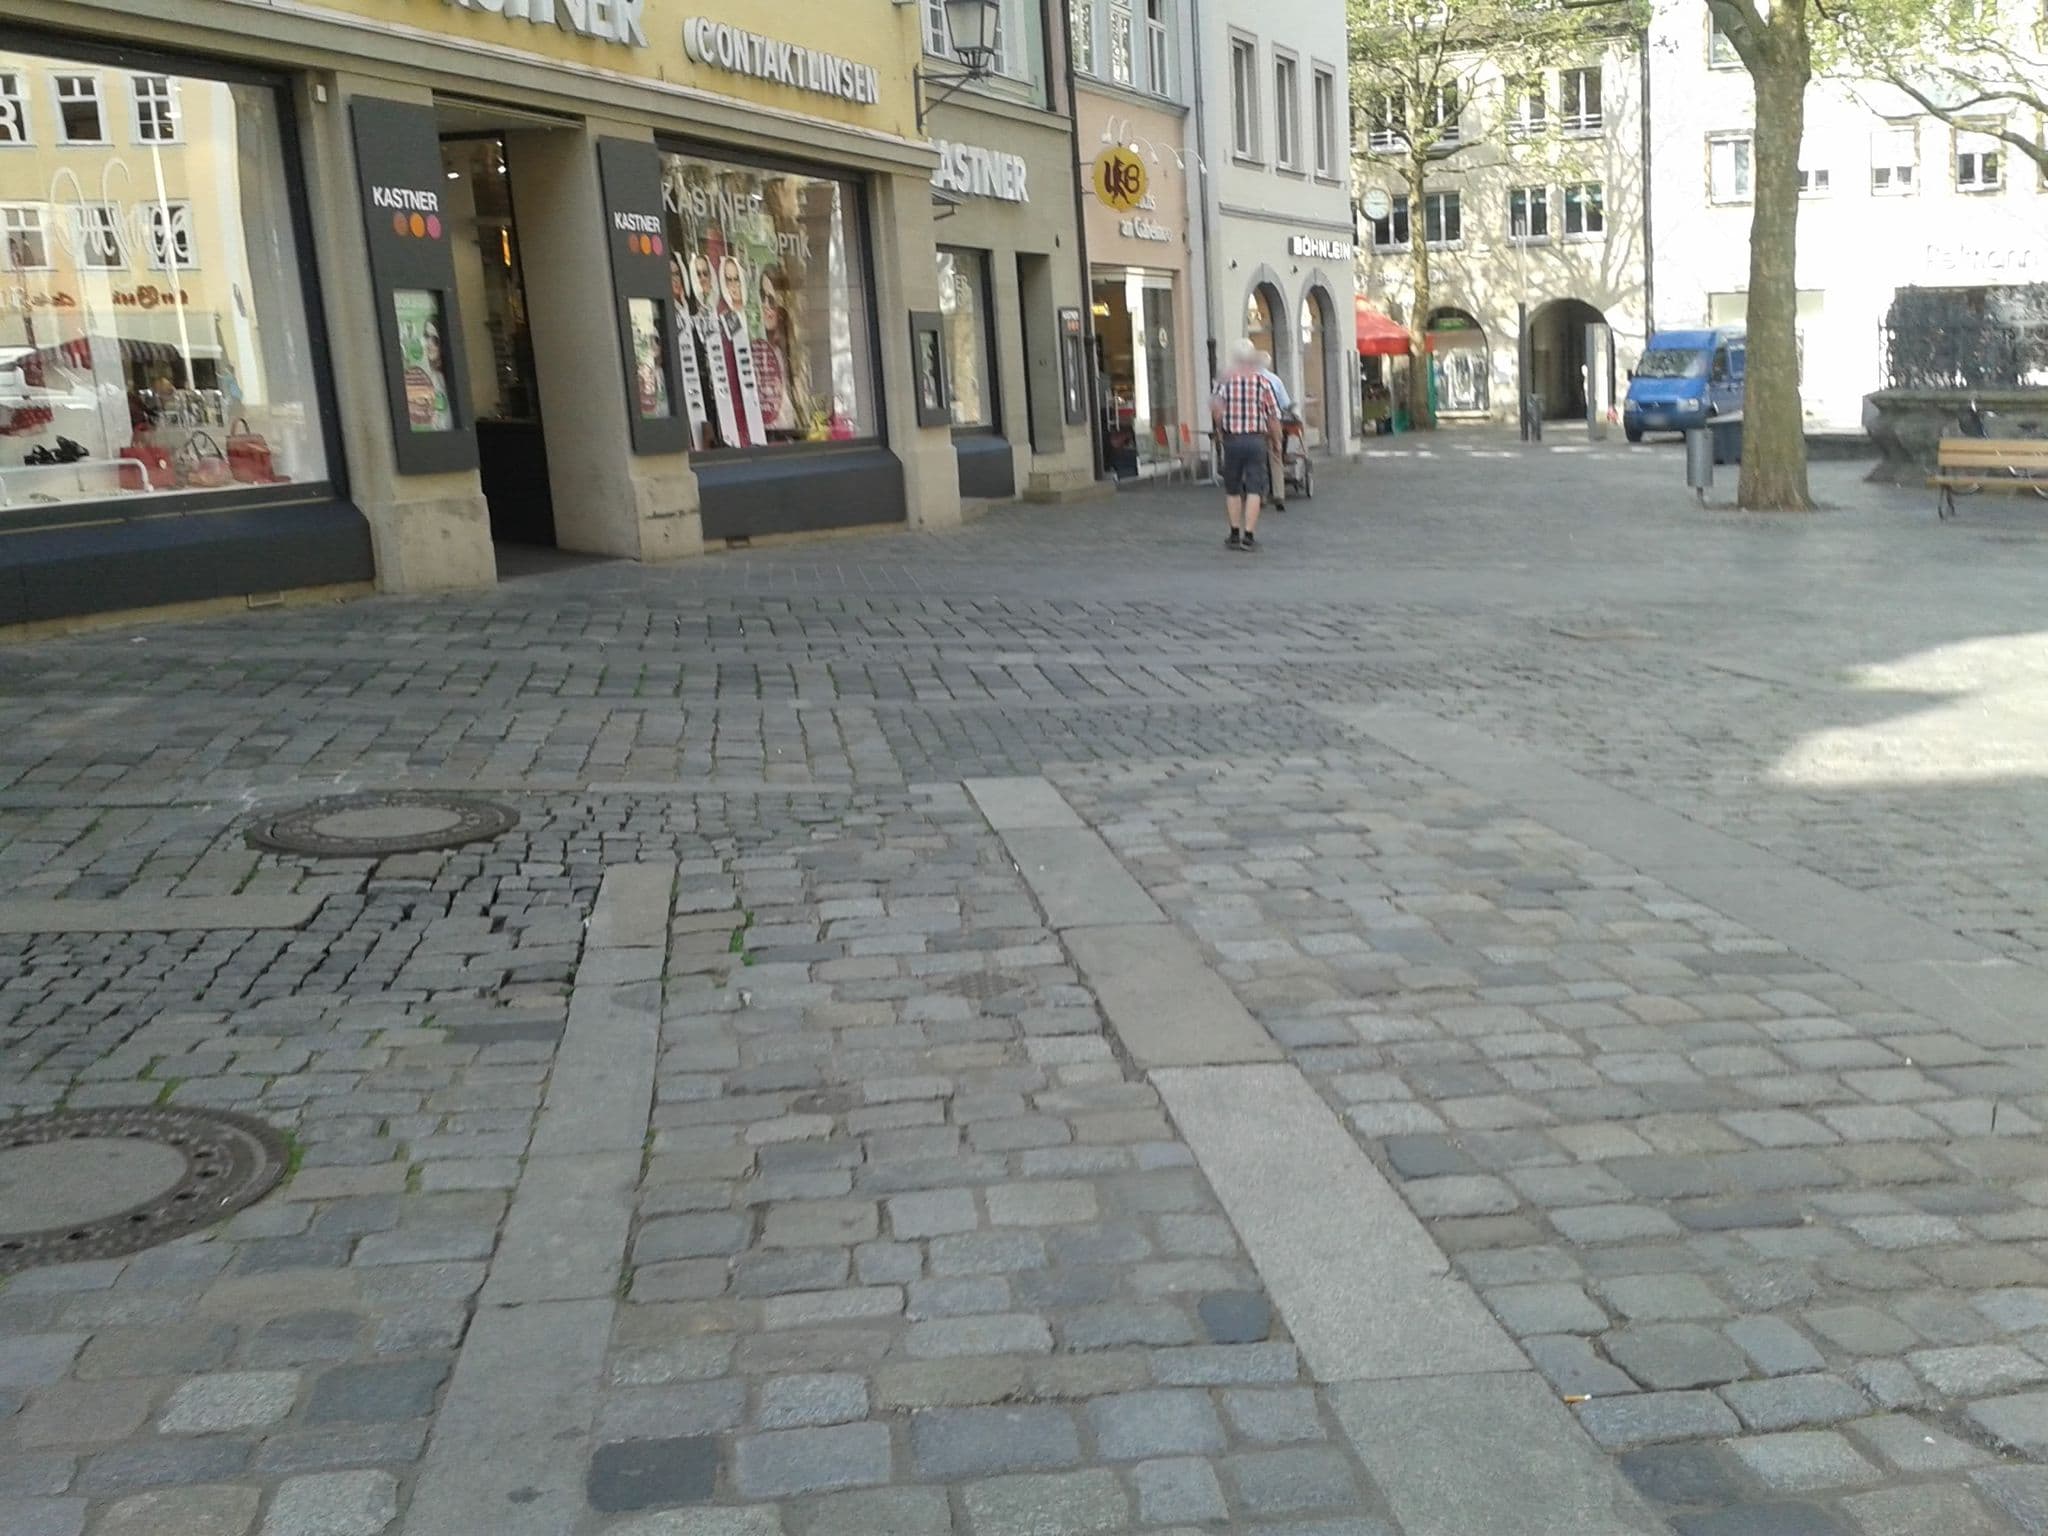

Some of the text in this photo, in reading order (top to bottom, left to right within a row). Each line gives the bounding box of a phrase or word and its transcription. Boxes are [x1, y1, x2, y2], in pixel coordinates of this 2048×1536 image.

[683, 16, 881, 105] CONTAKTLINSEN
[371, 185, 440, 212] KASTNER
[662, 181, 763, 232] KASTNER
[613, 210, 662, 234] KASTNER
